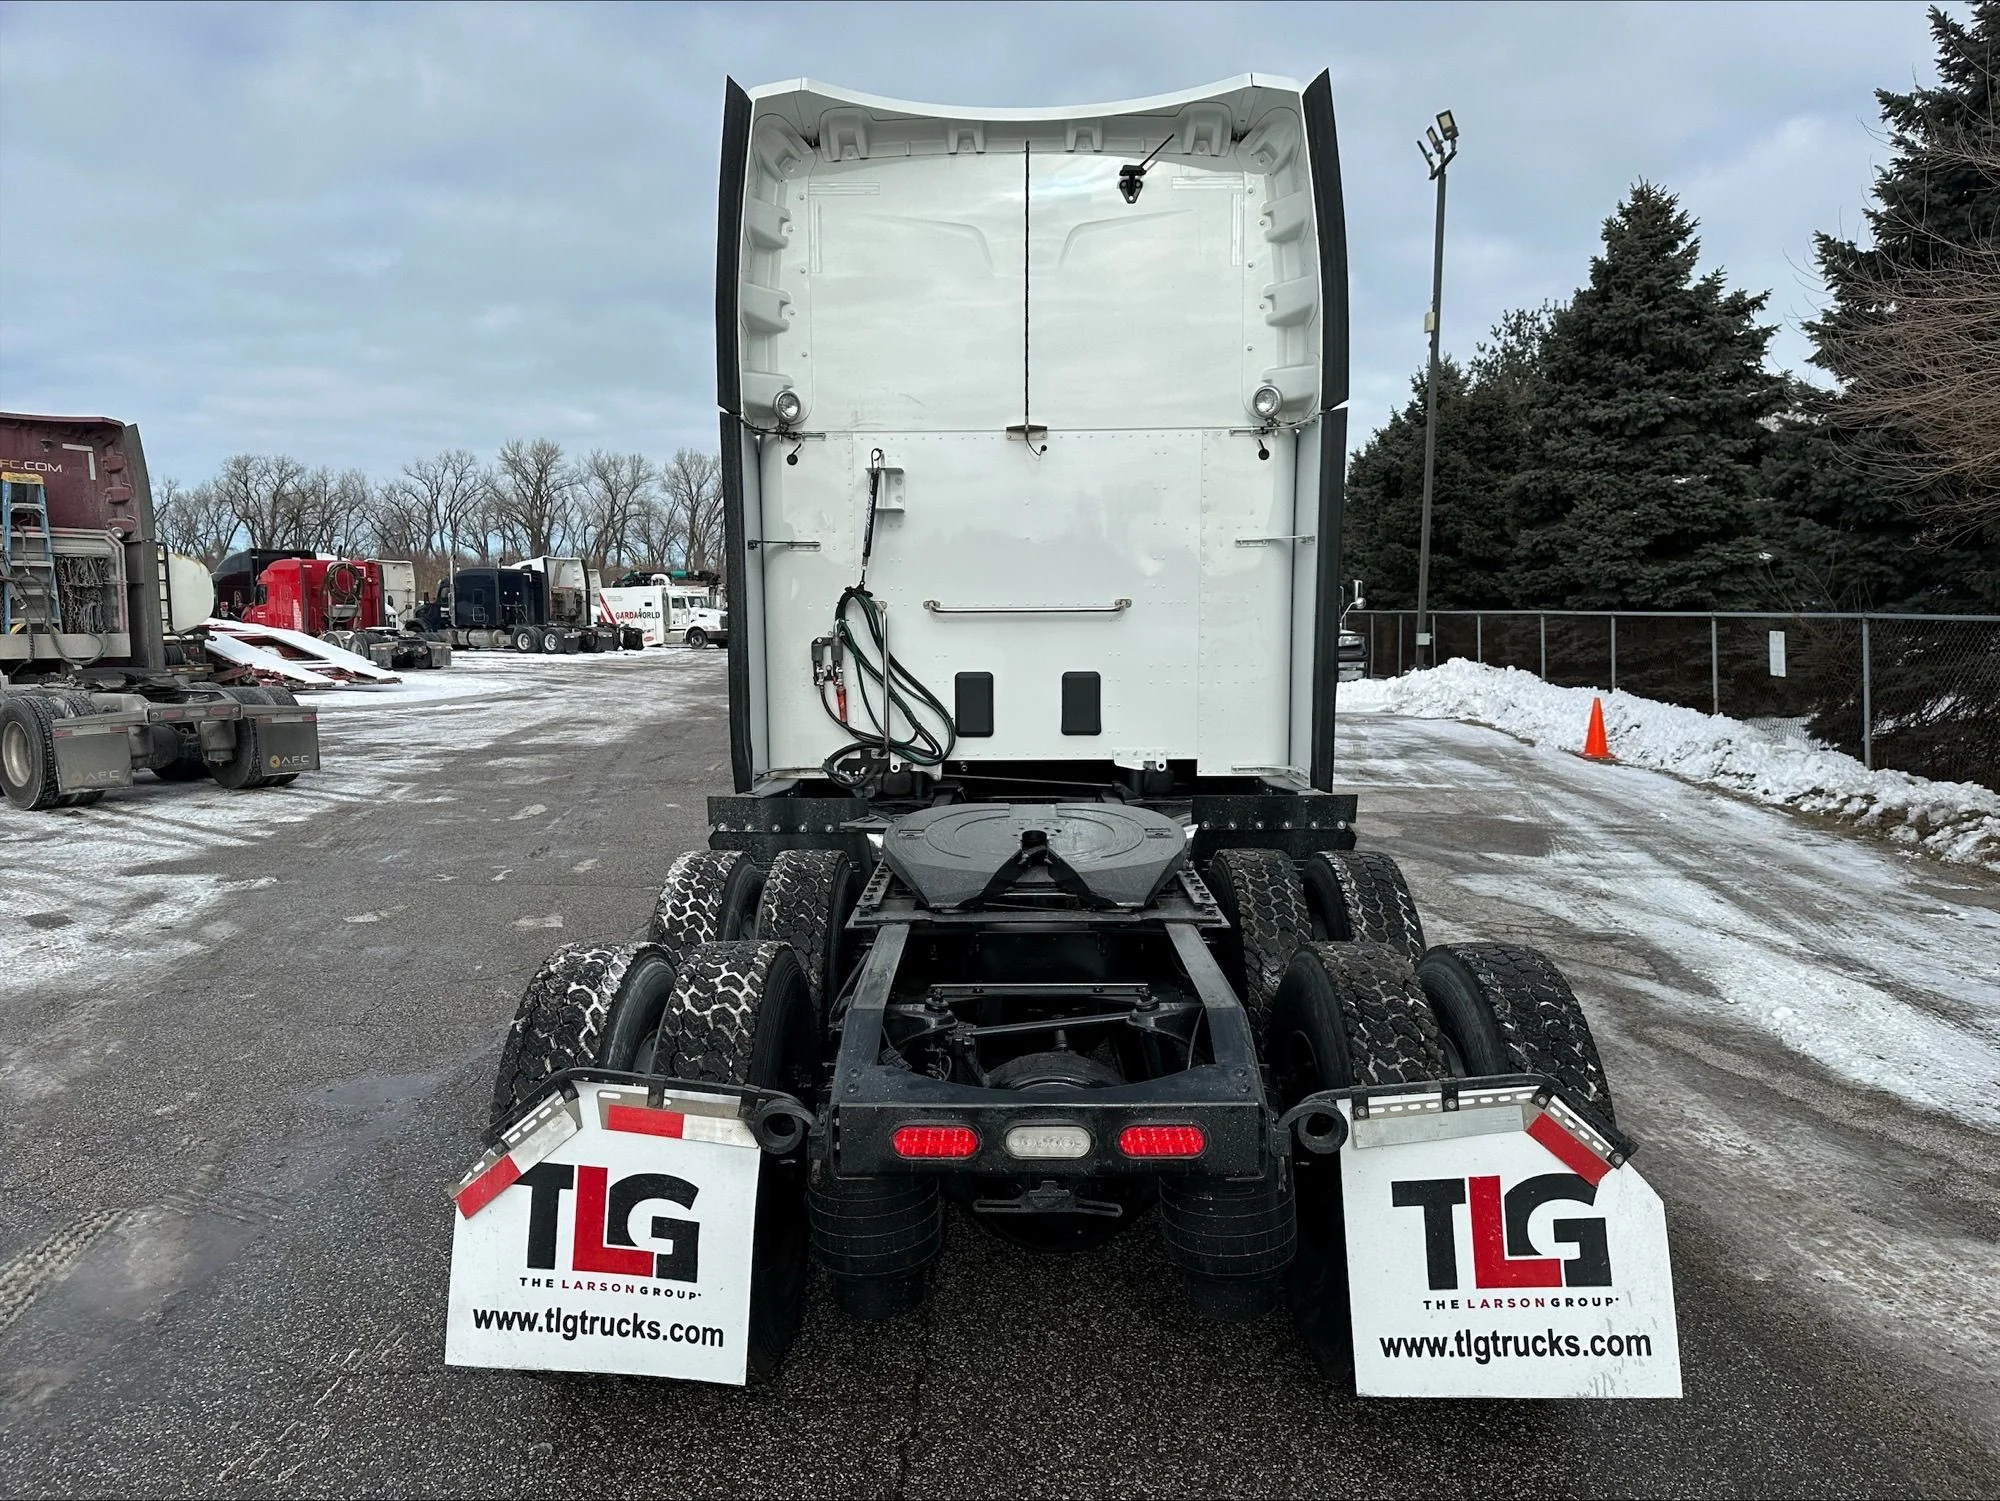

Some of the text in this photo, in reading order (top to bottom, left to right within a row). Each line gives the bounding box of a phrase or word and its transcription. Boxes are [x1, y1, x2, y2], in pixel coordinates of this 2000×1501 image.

[281, 755, 309, 763] AFC
[86, 770, 119, 780] AFC
[513, 1161, 700, 1283] TLG
[1391, 1173, 1612, 1290] TLG
[519, 1277, 554, 1288] THE
[562, 1280, 635, 1294] LARSON
[1423, 1300, 1460, 1310] THE
[1467, 1298, 1545, 1309] LARSON
[473, 1307, 724, 1347] www.tlgtrucks.com
[1379, 1328, 1651, 1364] www.tlgtrucks.com
